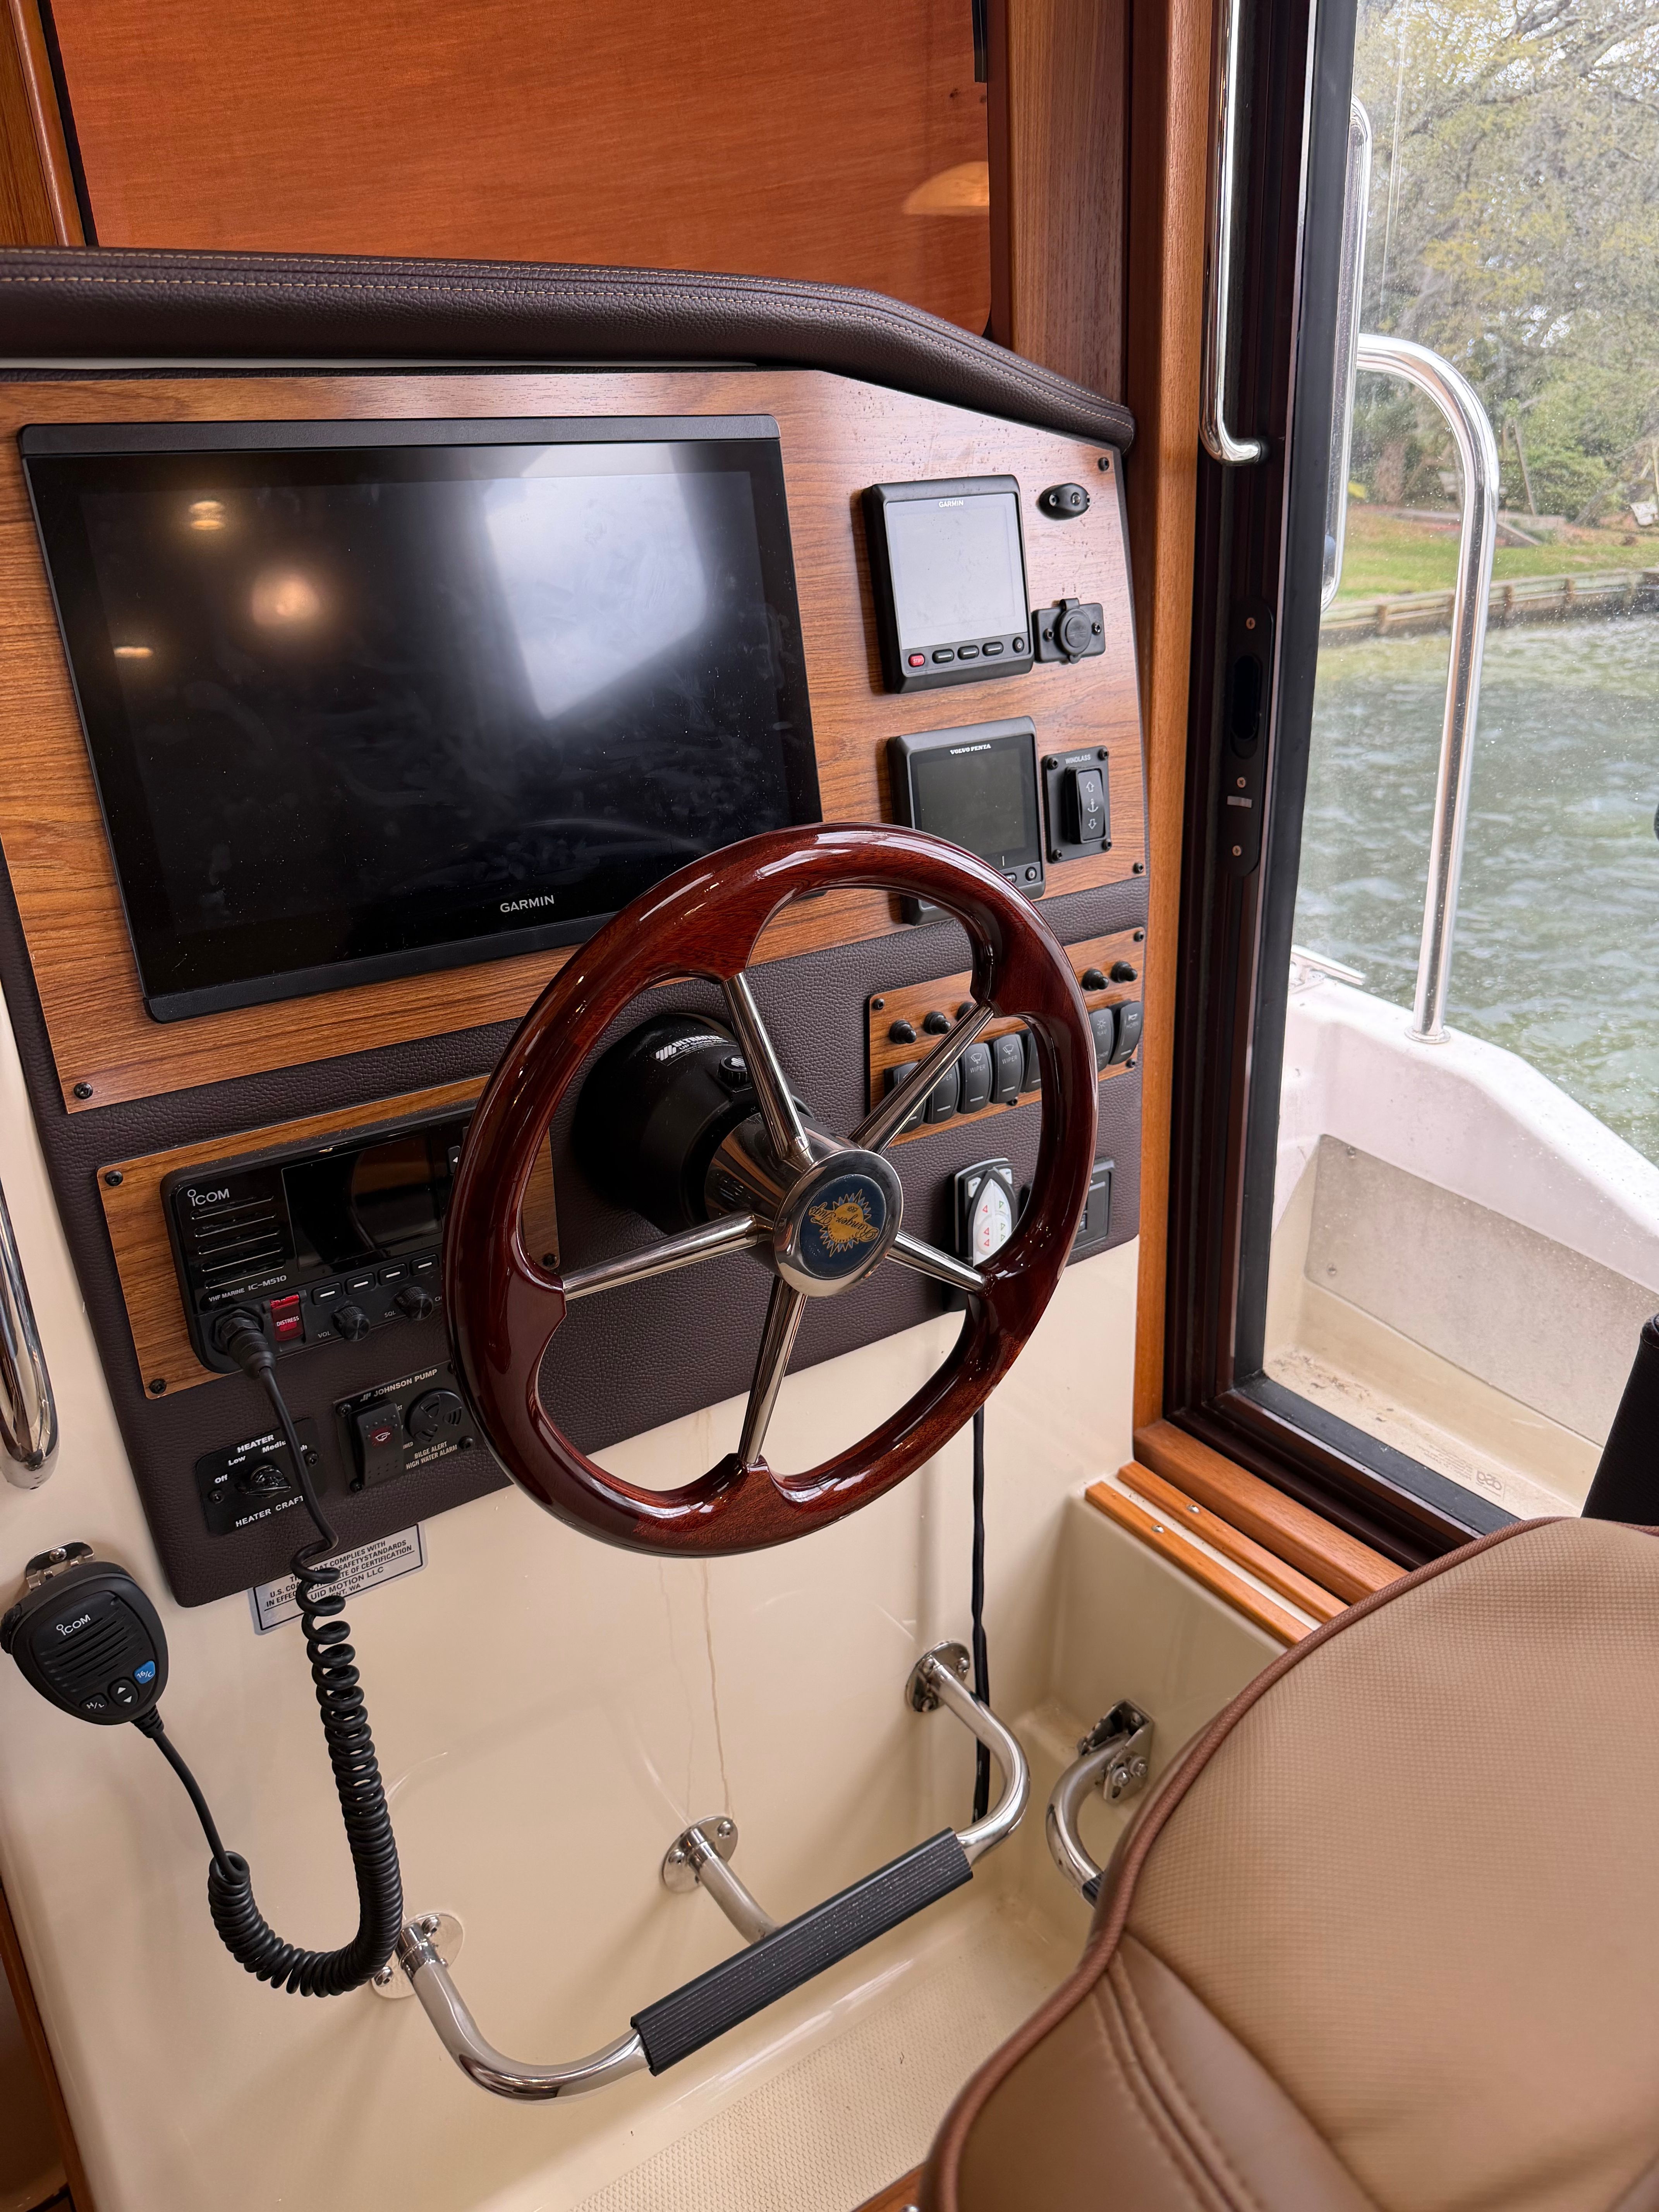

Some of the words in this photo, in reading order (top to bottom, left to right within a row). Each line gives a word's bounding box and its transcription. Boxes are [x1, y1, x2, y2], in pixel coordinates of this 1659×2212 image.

[950, 747, 970, 755] VOLVO
[970, 744, 991, 752] PENTA
[1065, 754, 1091, 764] WINDLASS
[500, 895, 555, 913] GARMIN
[970, 1064, 986, 1073] WIPER
[1002, 1054, 1018, 1065] WIPER
[810, 1202, 836, 1225] Tugs
[835, 1213, 879, 1239] Ranger
[208, 1294, 221, 1302] VHF
[222, 1288, 245, 1298] MARINE
[248, 1275, 287, 1291] IC-M510
[276, 1316, 300, 1327] DISTRESS
[374, 1378, 412, 1397] JOHNSON
[415, 1369, 438, 1382] PUMP
[237, 1434, 275, 1453] HEATER
[261, 1440, 287, 1453] Mediu
[414, 1448, 431, 1460] BILGE
[431, 1441, 447, 1453] ALERT
[228, 1455, 246, 1466] Low
[406, 1460, 419, 1470] HIGH
[421, 1452, 439, 1464] WATER
[440, 1444, 458, 1456] ALARM
[214, 1474, 228, 1484] Off
[235, 1508, 271, 1527] HEATER
[330, 1549, 366, 1567] COMPLIES
[367, 1540, 386, 1553] WITH
[266, 1599, 275, 1607] IN
[351, 1565, 360, 1573] OF
[361, 1544, 412, 1569] CERTIFICATION
[329, 1574, 364, 1593] MOTION
[367, 1566, 384, 1578] LLC
[270, 1589, 284, 1598] U.S.
[349, 1583, 361, 1591] WA
